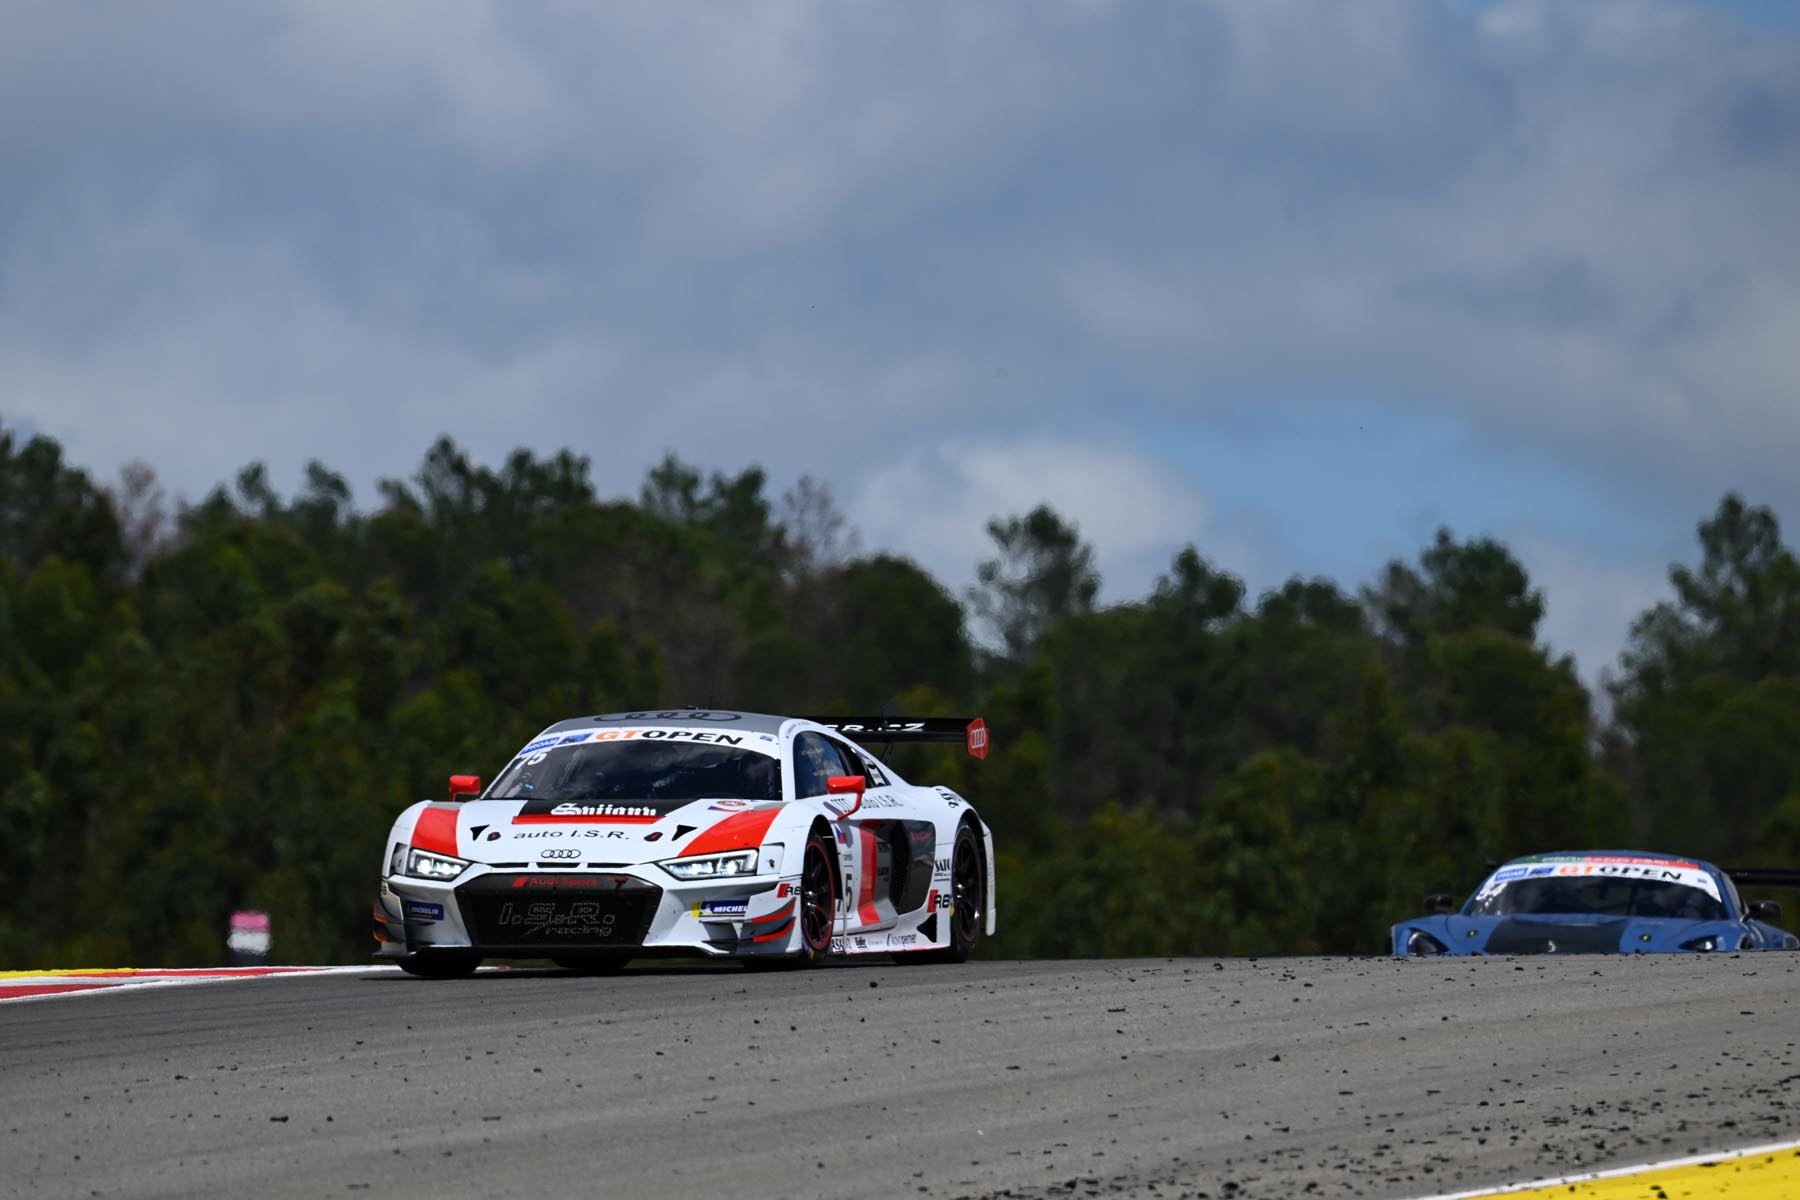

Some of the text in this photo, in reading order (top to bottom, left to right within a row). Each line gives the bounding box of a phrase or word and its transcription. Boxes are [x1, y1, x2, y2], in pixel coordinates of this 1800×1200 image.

[513, 829, 630, 840] auto I.S.R.
[528, 877, 598, 887] Audi Sport
